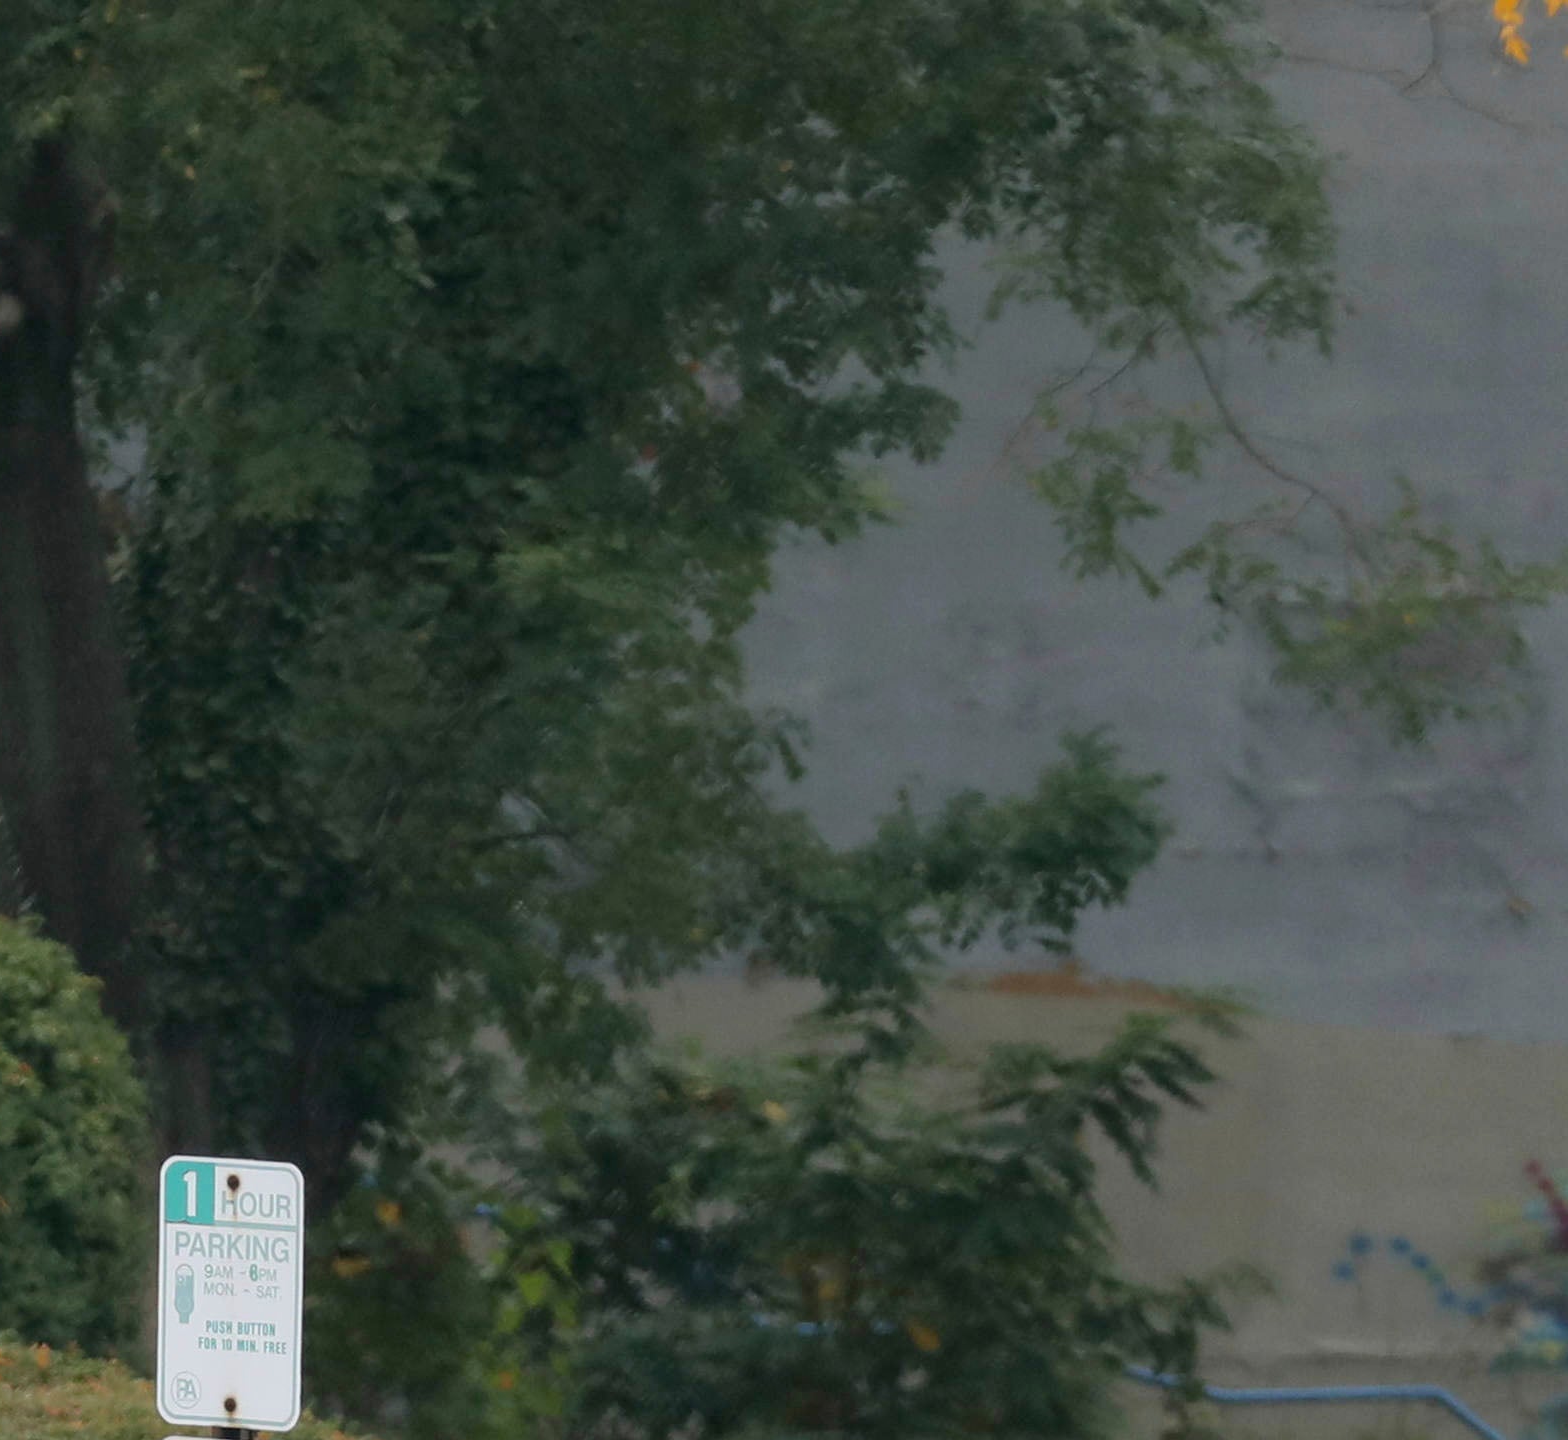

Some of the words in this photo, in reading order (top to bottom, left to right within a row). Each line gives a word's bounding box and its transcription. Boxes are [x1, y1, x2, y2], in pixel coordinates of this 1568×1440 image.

[183, 1171, 197, 1217] 1
[221, 1191, 291, 1219] HOUR
[174, 1231, 289, 1263] PARKING
[204, 1264, 234, 1281] 9AM
[206, 1320, 232, 1335] PUSH
[237, 1321, 276, 1337] BUTTON
[198, 1338, 216, 1351] FOR
[222, 1339, 233, 1351] 10
[237, 1340, 259, 1353] MIN.
[264, 1341, 287, 1355] FREE
